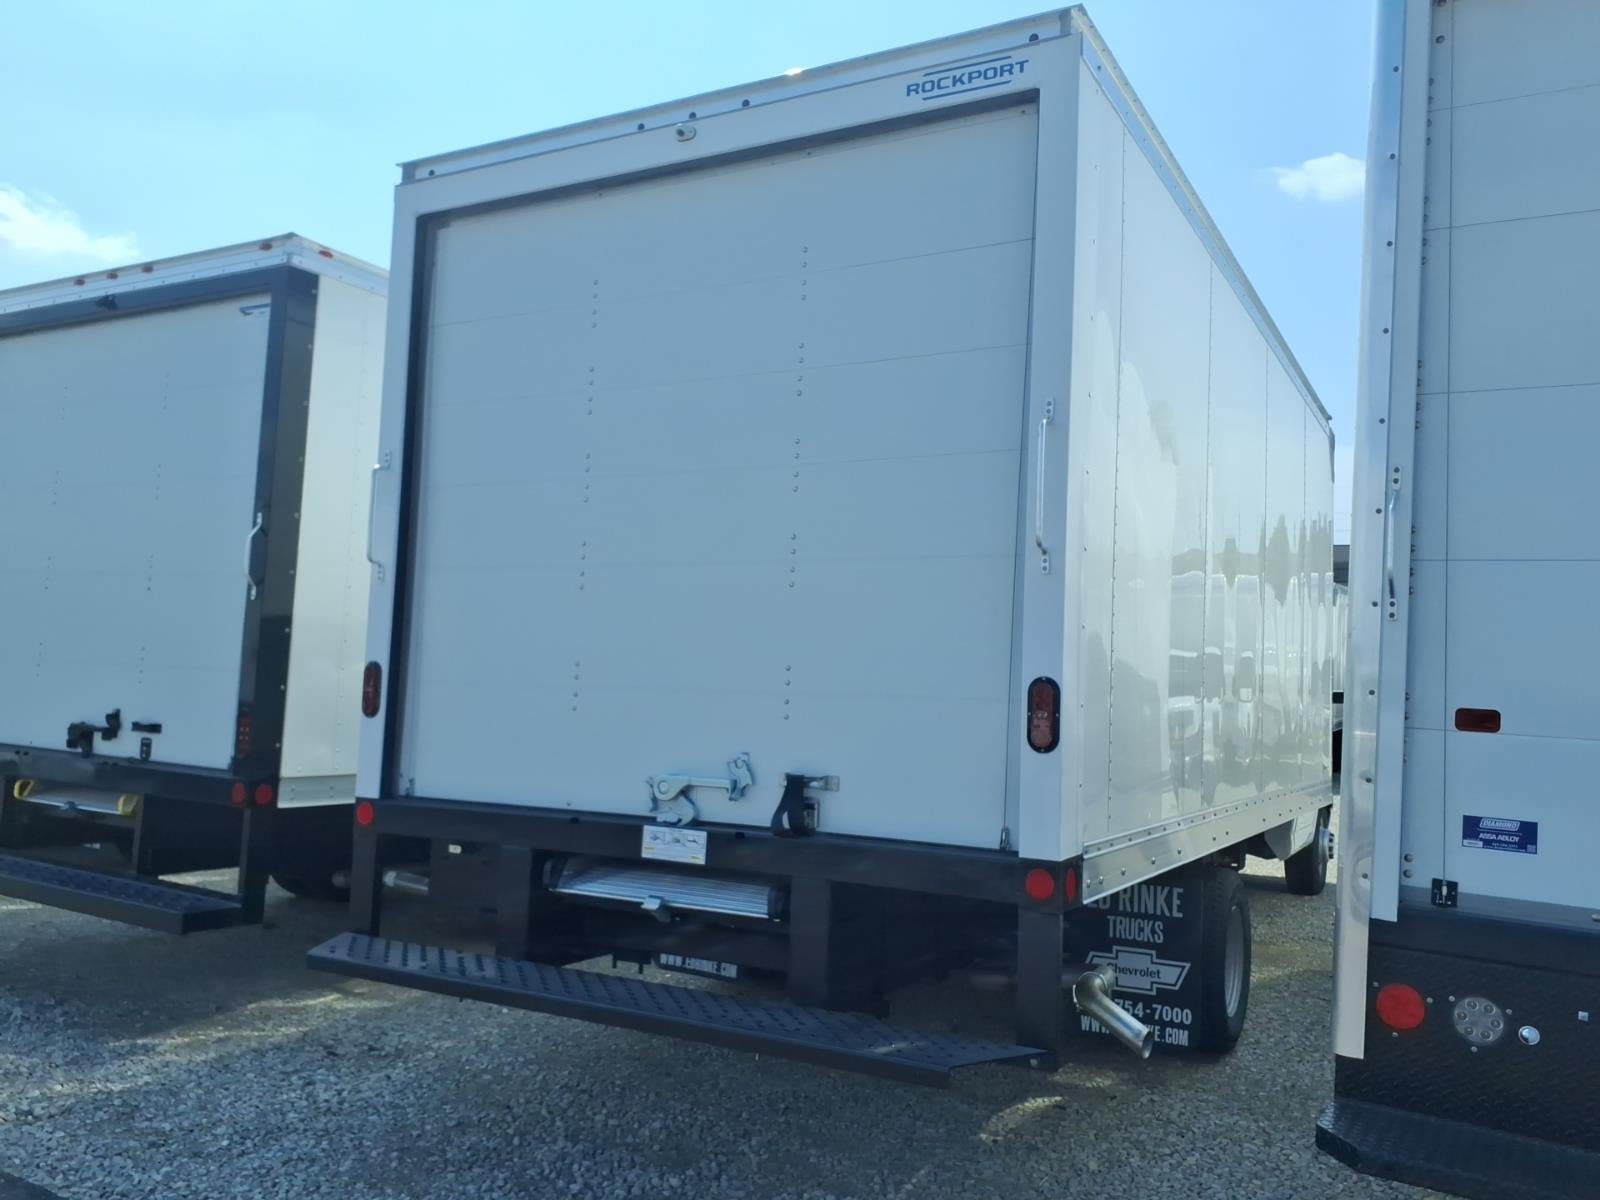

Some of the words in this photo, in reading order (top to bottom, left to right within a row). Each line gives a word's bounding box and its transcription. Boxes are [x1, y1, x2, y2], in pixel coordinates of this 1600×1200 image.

[905, 59, 1030, 97] ROCKPORT
[1118, 884, 1184, 918] RINKE
[1106, 915, 1164, 944] TRUCKS
